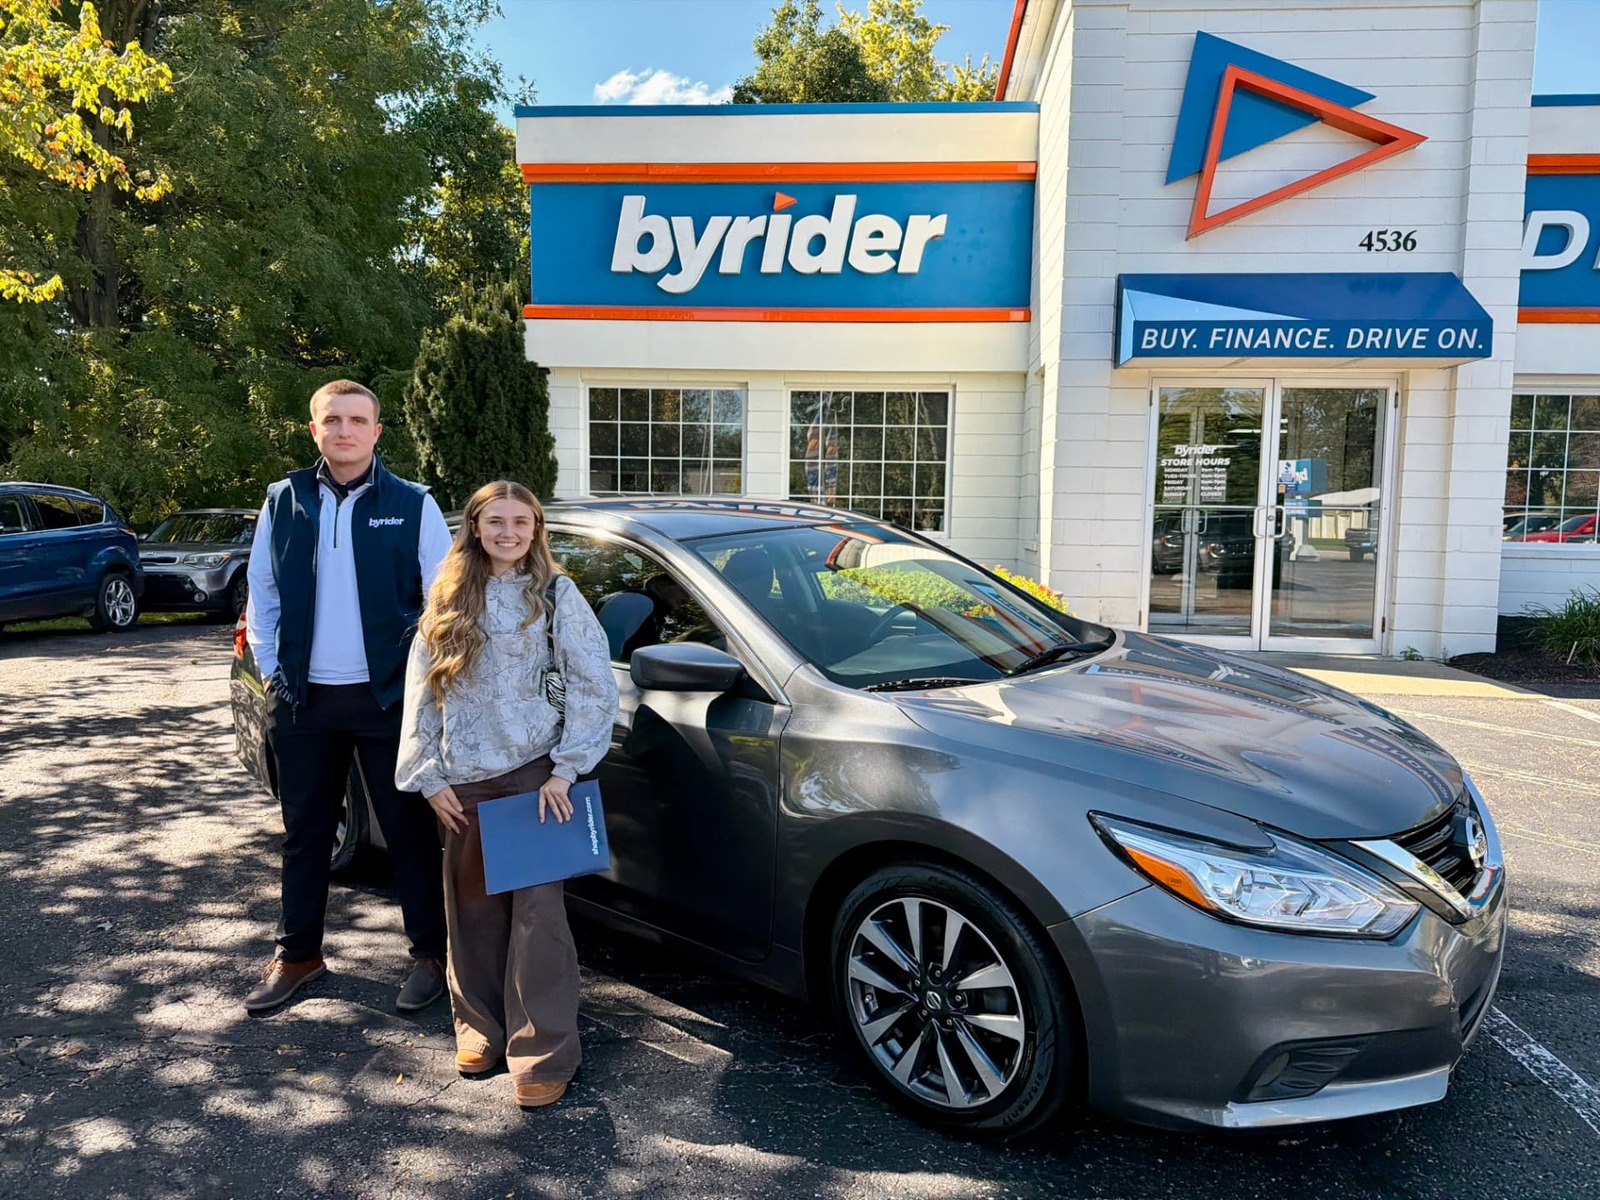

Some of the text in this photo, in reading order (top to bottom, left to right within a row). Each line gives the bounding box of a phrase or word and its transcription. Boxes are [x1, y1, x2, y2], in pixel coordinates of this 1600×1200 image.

[610, 191, 948, 294] byrider
[1358, 229, 1418, 252] 4536
[1519, 210, 1600, 270] D
[1141, 328, 1483, 349] BUY. FINANCE. DRIVE ON.
[1161, 458, 1231, 467] STORE HOURS
[369, 516, 405, 528] byrider
[585, 796, 599, 856] shopbyrider.com
